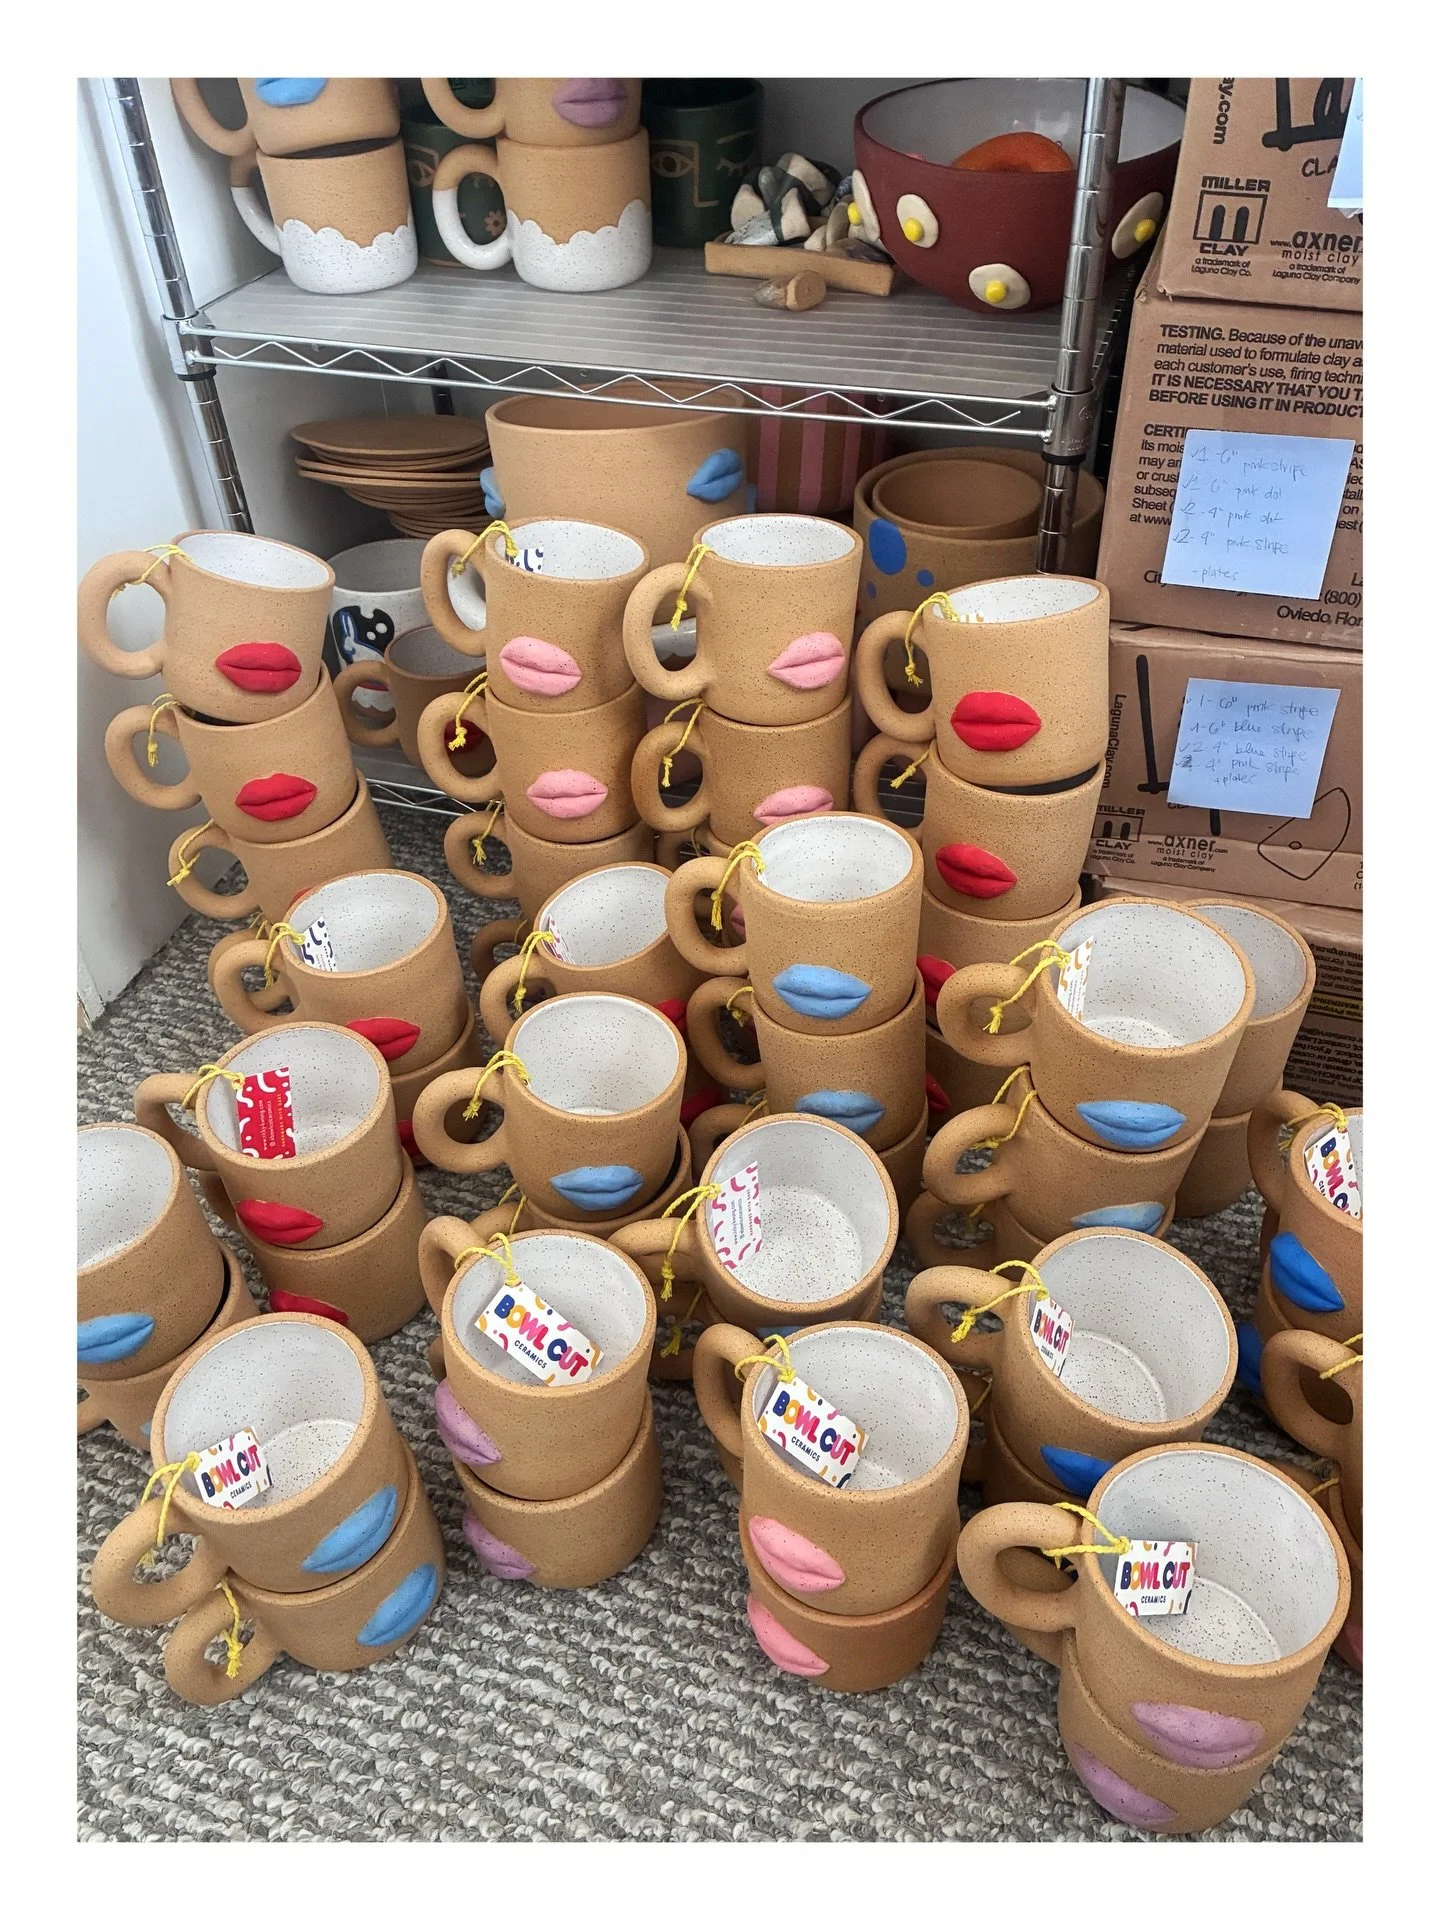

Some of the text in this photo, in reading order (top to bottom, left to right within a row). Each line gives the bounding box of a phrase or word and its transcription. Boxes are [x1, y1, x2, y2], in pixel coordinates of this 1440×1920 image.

[1202, 175, 1271, 192] MILLER
[1200, 243, 1249, 256] CLAY
[1282, 249, 1359, 267] moist clay
[1203, 257, 1240, 267] trademark
[1297, 263, 1336, 274] trademark
[1191, 265, 1252, 277] Laguna Clay Co.
[1272, 270, 1361, 285] Laguna Clay Company
[1160, 324, 1226, 341] TESTING.
[1229, 328, 1286, 344] Because
[1289, 333, 1305, 346] of
[1305, 334, 1326, 347] the
[1157, 343, 1206, 356] material
[1209, 346, 1241, 359] used
[1244, 348, 1257, 360] to
[1259, 348, 1321, 364] formulate
[1323, 353, 1350, 369] clay
[1154, 359, 1185, 372] each
[1188, 362, 1256, 377] customer's
[1259, 366, 1286, 380] use,
[1290, 367, 1321, 383] firing
[1152, 373, 1166, 386] IT
[1168, 375, 1181, 388] IS
[1184, 376, 1275, 394] NECESSARY
[1277, 382, 1318, 397] THAT
[1318, 386, 1350, 400] YOU
[1149, 389, 1208, 405] BEFORE
[1211, 394, 1257, 409] USING
[1259, 397, 1271, 410] IT
[1275, 399, 1291, 413] IN
[1144, 424, 1187, 438] CERTI
[1141, 439, 1155, 451] its
[1139, 456, 1165, 469] may
[1136, 471, 1149, 480] or
[1132, 498, 1167, 511] Sheet
[1129, 513, 1141, 523] at
[1324, 589, 1362, 608] (800)
[1277, 605, 1332, 624] Oviedo,
[1095, 839, 1132, 850] CLAY
[1098, 849, 1127, 858] trademark
[1157, 846, 1213, 861] moist clay
[1168, 856, 1197, 866] trademark
[1150, 860, 1172, 868] Laguna
[1187, 864, 1216, 873] Company
[1320, 1136, 1344, 1198] BOWL
[494, 1294, 589, 1377] BOWL CUT
[1033, 1308, 1070, 1354] BOWL CUT
[514, 1339, 548, 1369] CERAMICS
[772, 1390, 856, 1466] BOWL CUT
[791, 1436, 821, 1462] CERAMICS
[201, 1444, 261, 1498] BOWL CUT
[229, 1481, 252, 1499] CERAMICS
[1120, 1561, 1191, 1590] BOWL CUT
[1140, 1595, 1167, 1604] CERAMICS
